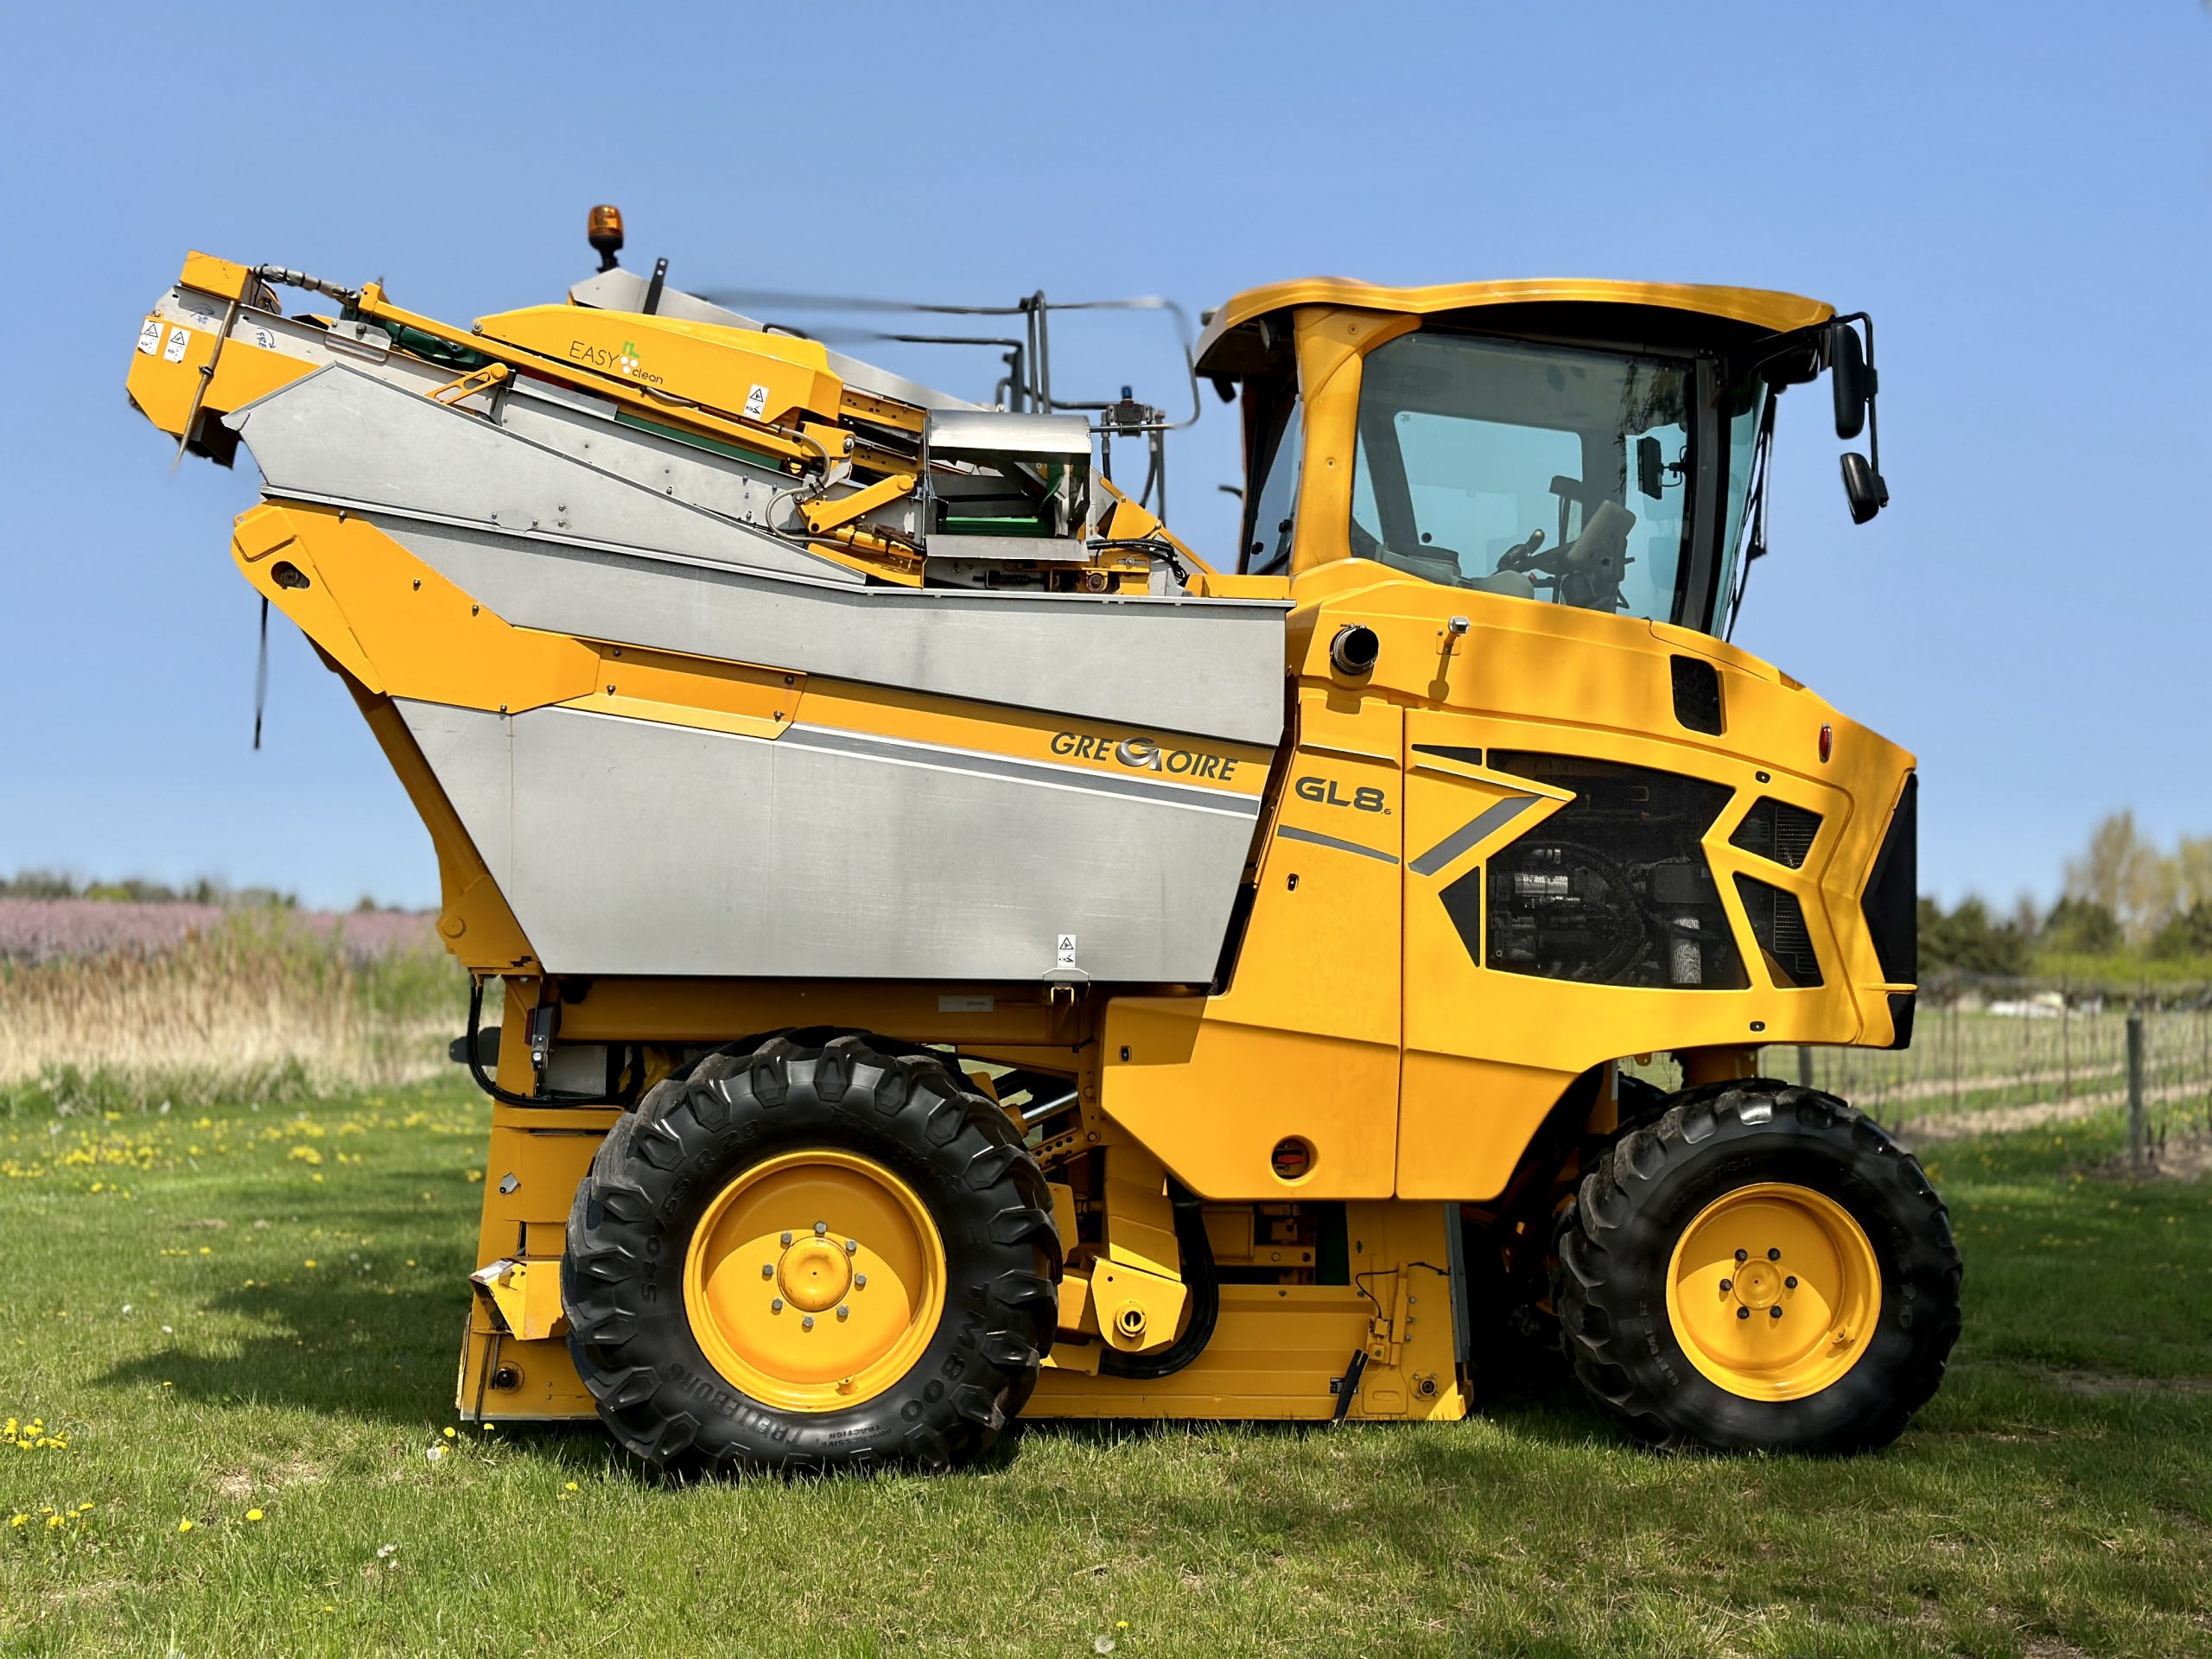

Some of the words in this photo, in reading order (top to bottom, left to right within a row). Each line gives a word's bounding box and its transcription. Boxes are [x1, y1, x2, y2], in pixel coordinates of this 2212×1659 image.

[569, 340, 620, 369] EASY
[632, 367, 664, 385] clean
[1051, 732, 1238, 781] GREGOIRE
